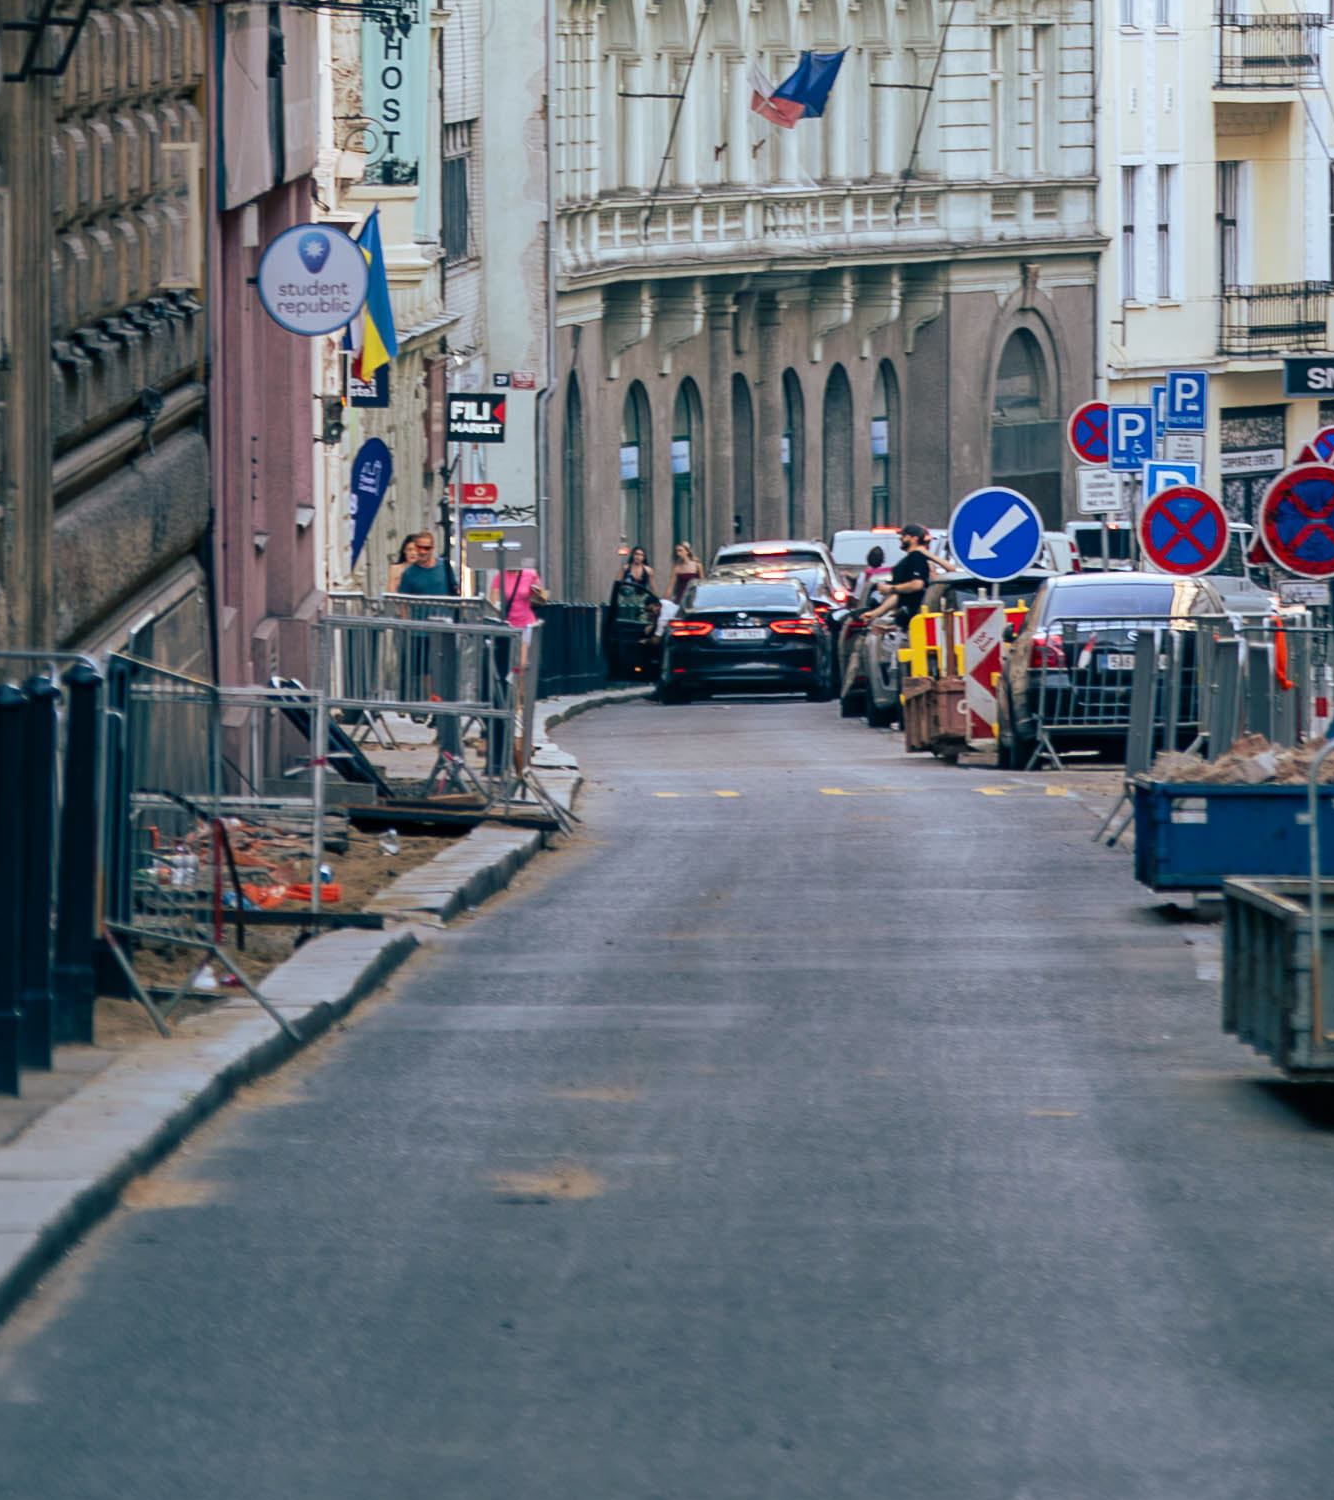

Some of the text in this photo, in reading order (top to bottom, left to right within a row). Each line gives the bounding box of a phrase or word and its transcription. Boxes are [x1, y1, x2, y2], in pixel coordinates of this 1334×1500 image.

[381, 36, 403, 154] HOST
[277, 280, 349, 297] student
[277, 297, 351, 318] republic
[1174, 377, 1200, 413] P
[450, 401, 491, 421] FILI
[450, 422, 503, 434] MARKET
[1117, 412, 1146, 452] P
